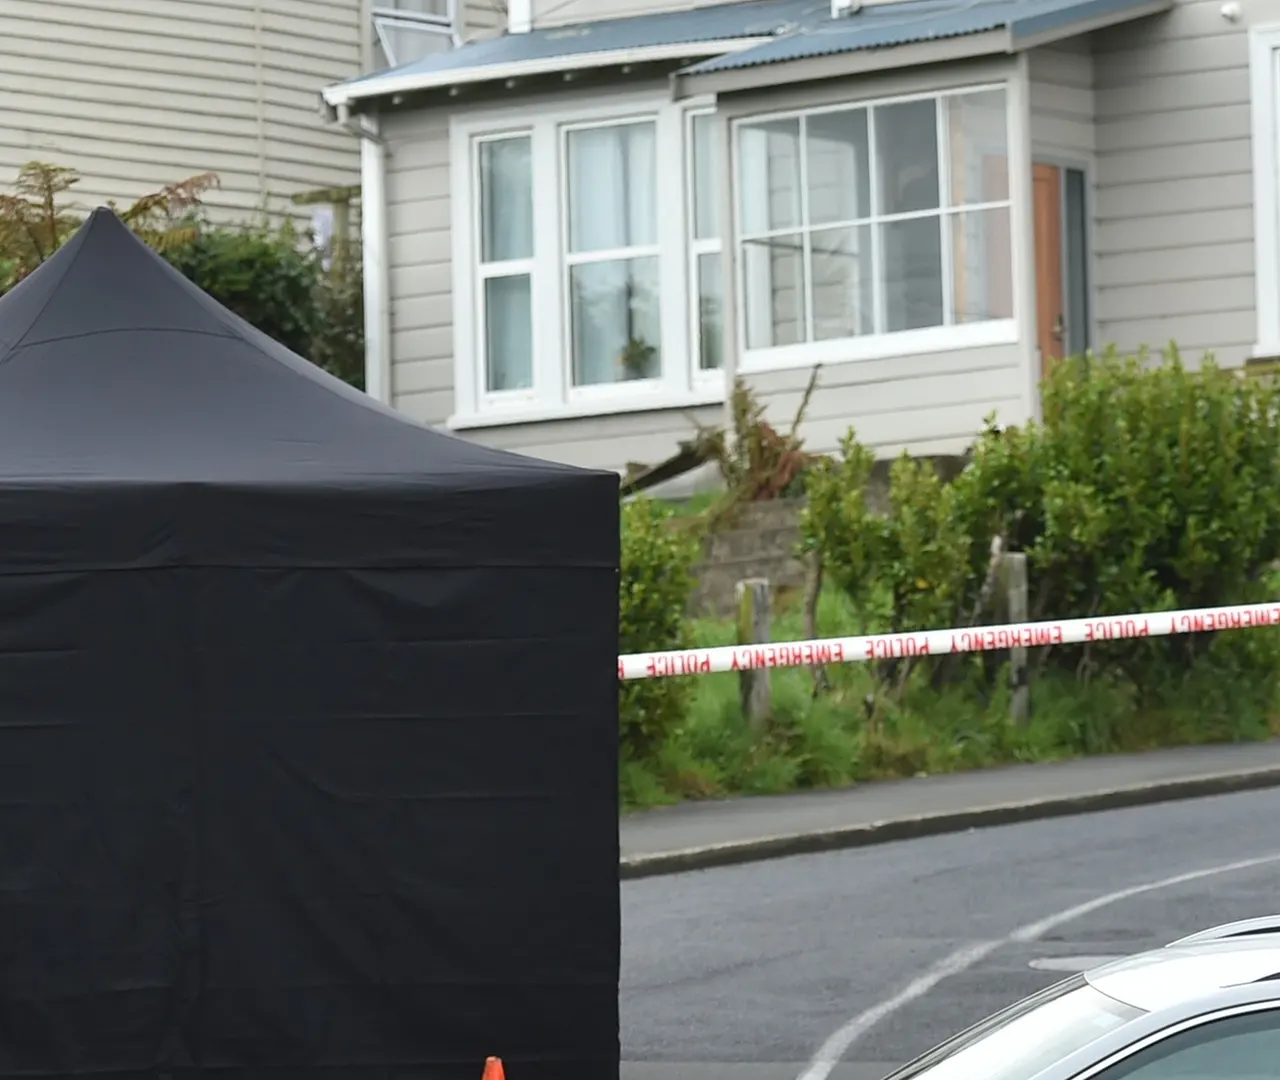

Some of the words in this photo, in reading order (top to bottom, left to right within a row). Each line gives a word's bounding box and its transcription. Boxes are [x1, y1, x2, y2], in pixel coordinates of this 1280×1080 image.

[865, 636, 930, 660] POLICE
[951, 625, 1064, 653] EMERGENCY
[648, 653, 712, 678] POLICE
[731, 643, 844, 671] EMERGENCY
